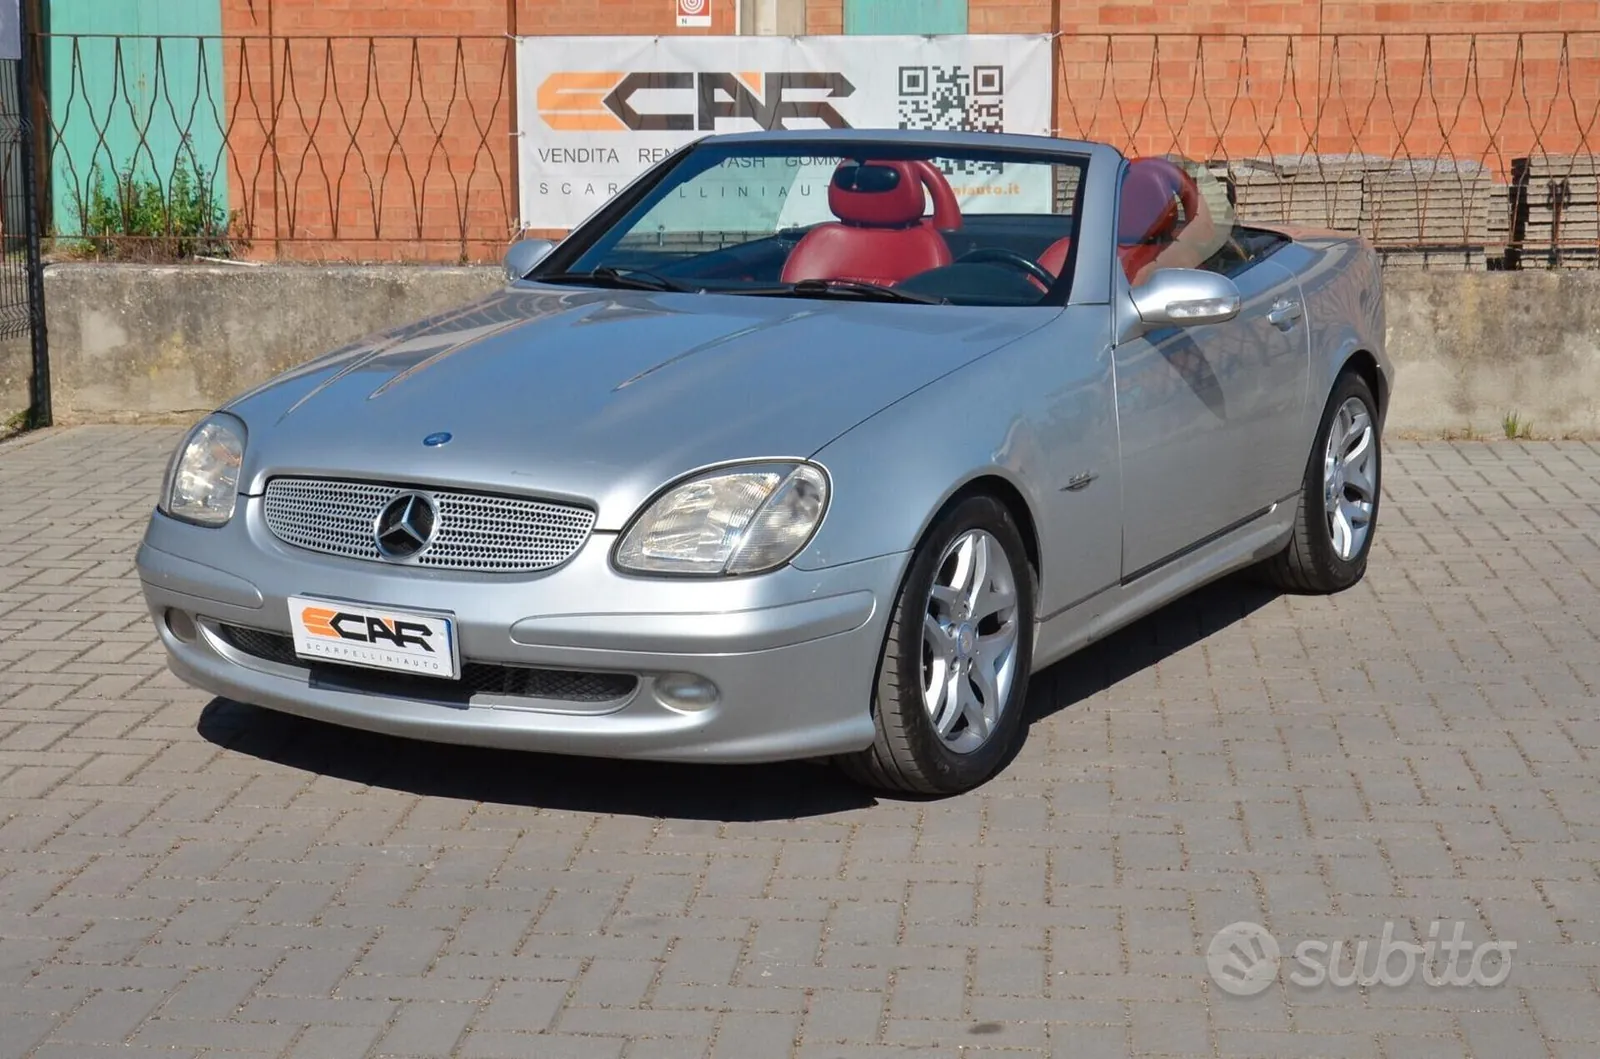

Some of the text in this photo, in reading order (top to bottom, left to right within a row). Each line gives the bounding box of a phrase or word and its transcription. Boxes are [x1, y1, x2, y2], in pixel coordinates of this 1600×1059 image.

[538, 148, 840, 168] VENDITA REN ASH GOMM
[306, 643, 439, 670] SCARPELLINIAUTO
